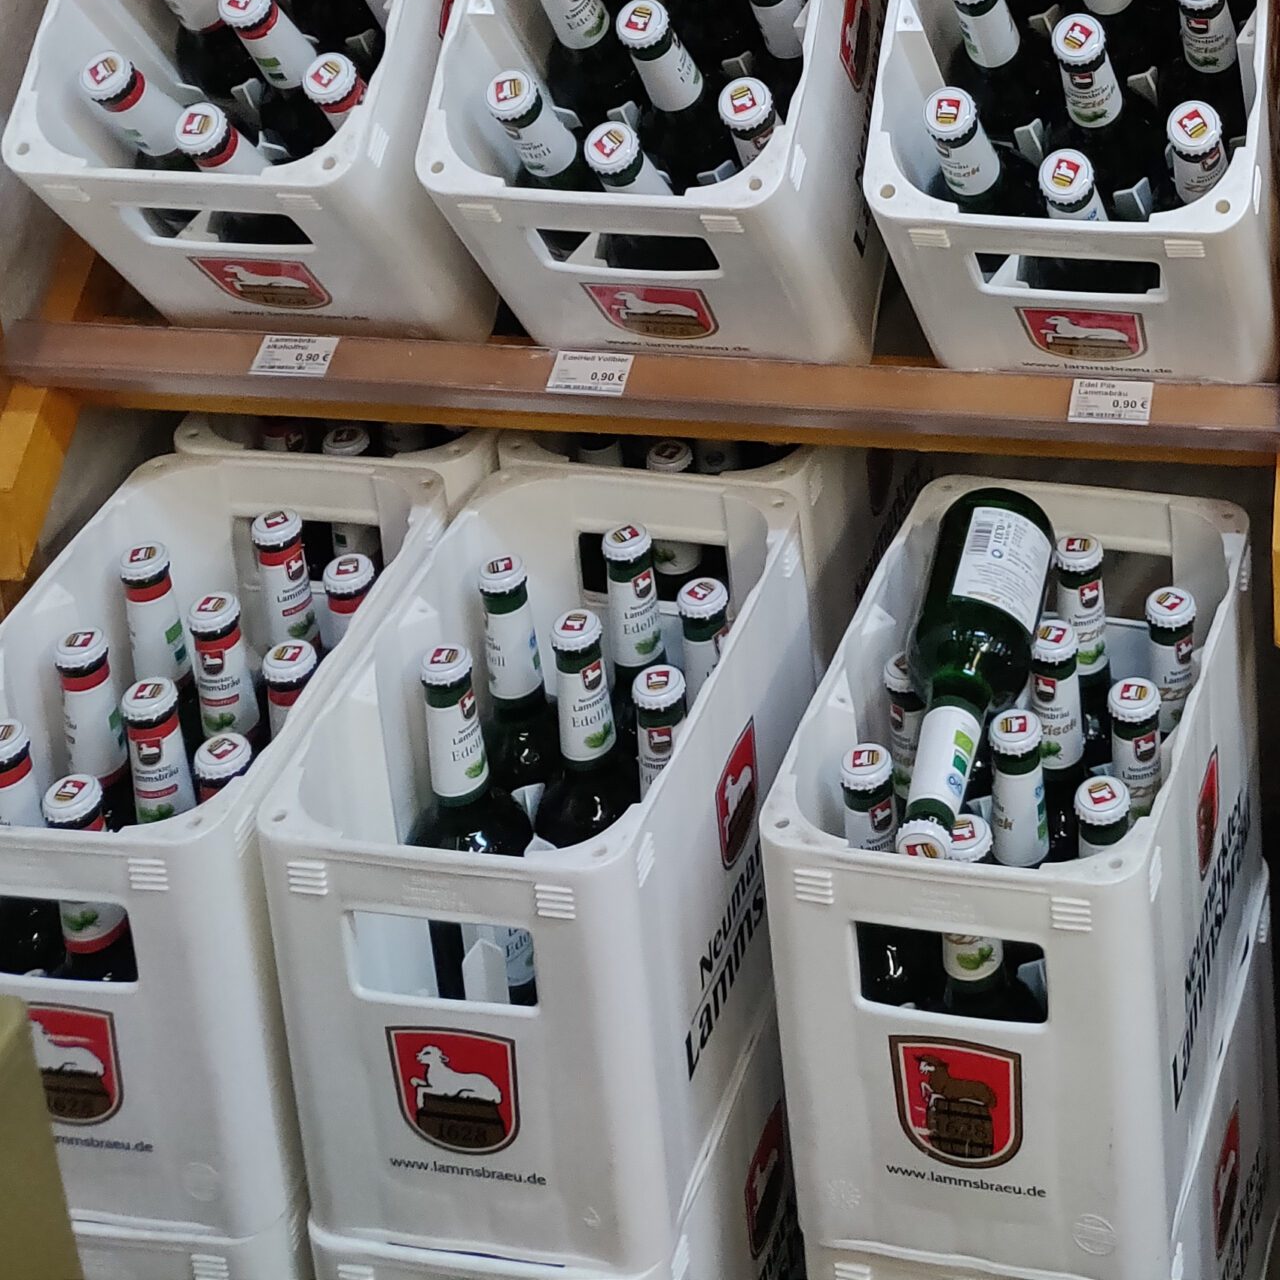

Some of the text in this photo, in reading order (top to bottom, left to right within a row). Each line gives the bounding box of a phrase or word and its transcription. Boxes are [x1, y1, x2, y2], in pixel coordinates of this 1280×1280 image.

[296, 354, 319, 362] 0,90
[591, 372, 615, 382] 0,90
[1112, 400, 1137, 409] 0,90
[886, 1162, 1047, 1199] www.lammsbraeu.de
